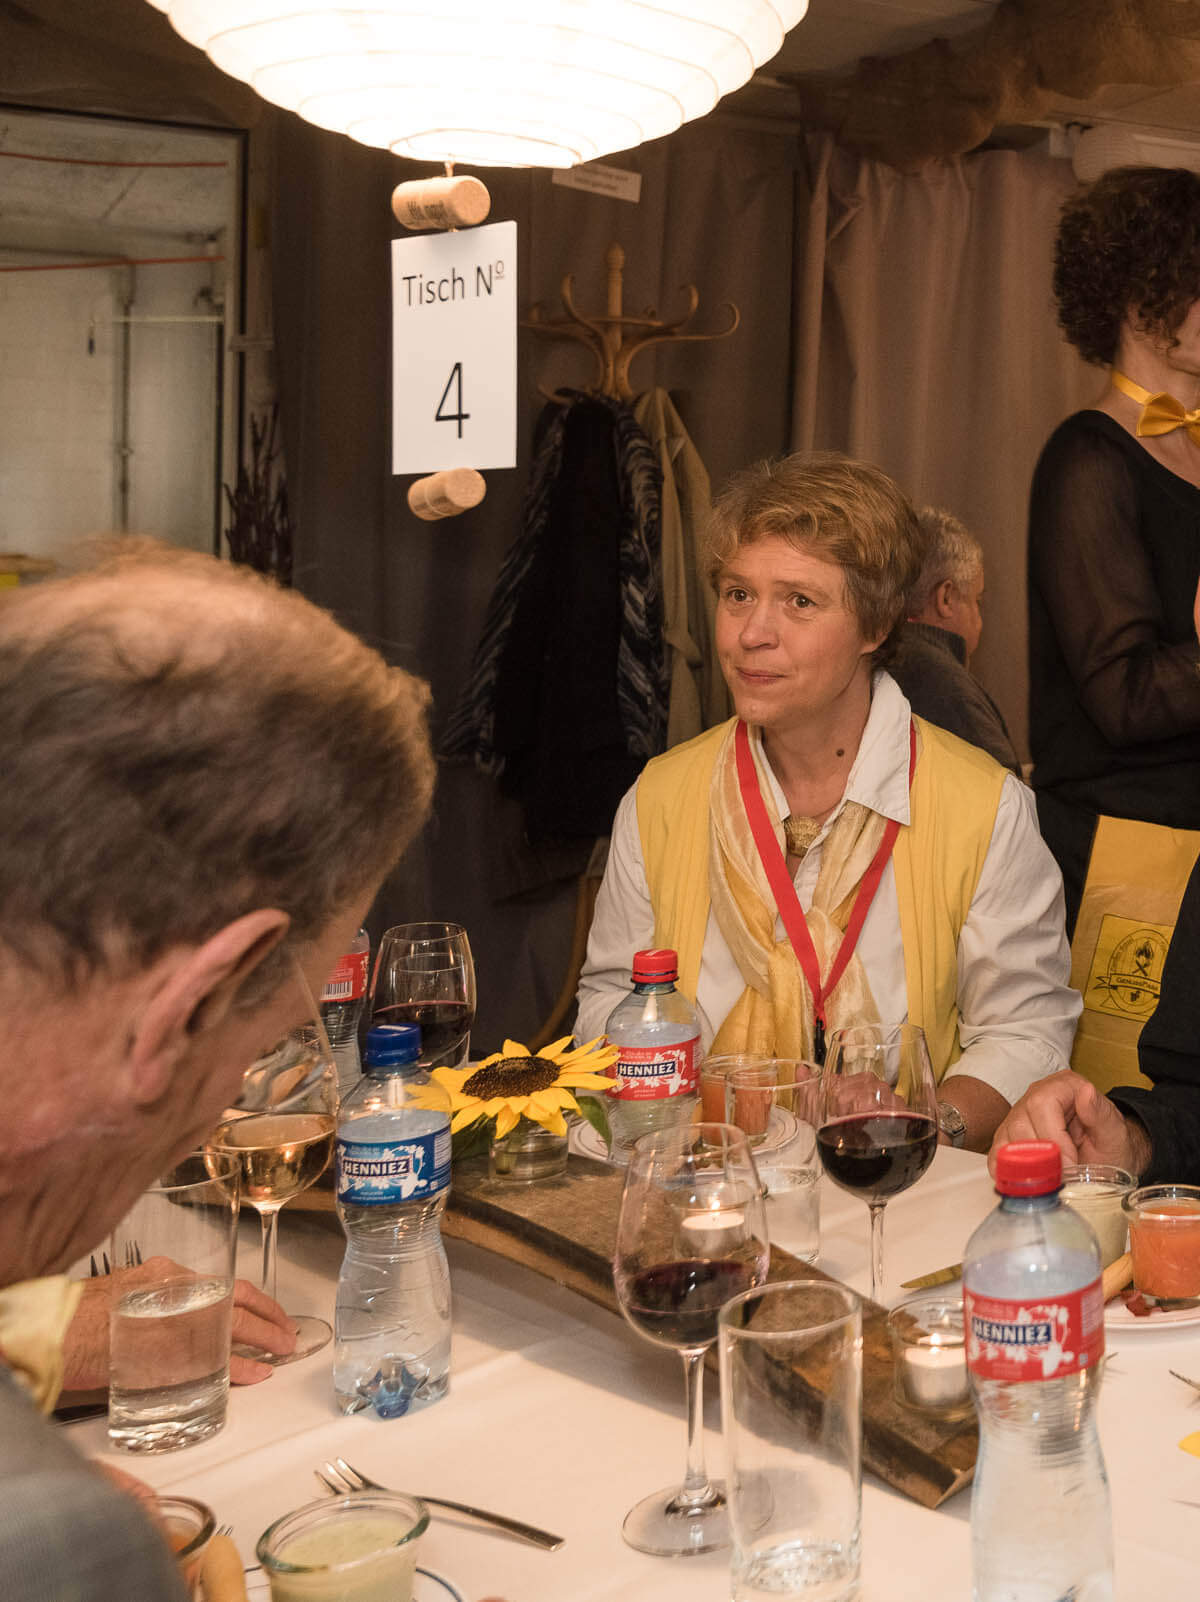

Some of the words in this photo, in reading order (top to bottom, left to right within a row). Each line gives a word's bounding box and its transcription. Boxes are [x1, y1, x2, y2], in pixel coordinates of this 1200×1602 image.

[402, 267, 465, 307] Tisch
[435, 361, 470, 440] 4
[619, 1062, 674, 1076] HENNIEZ
[343, 1160, 408, 1176] HENNIEZ
[973, 1317, 1049, 1343] HENNIEZ
